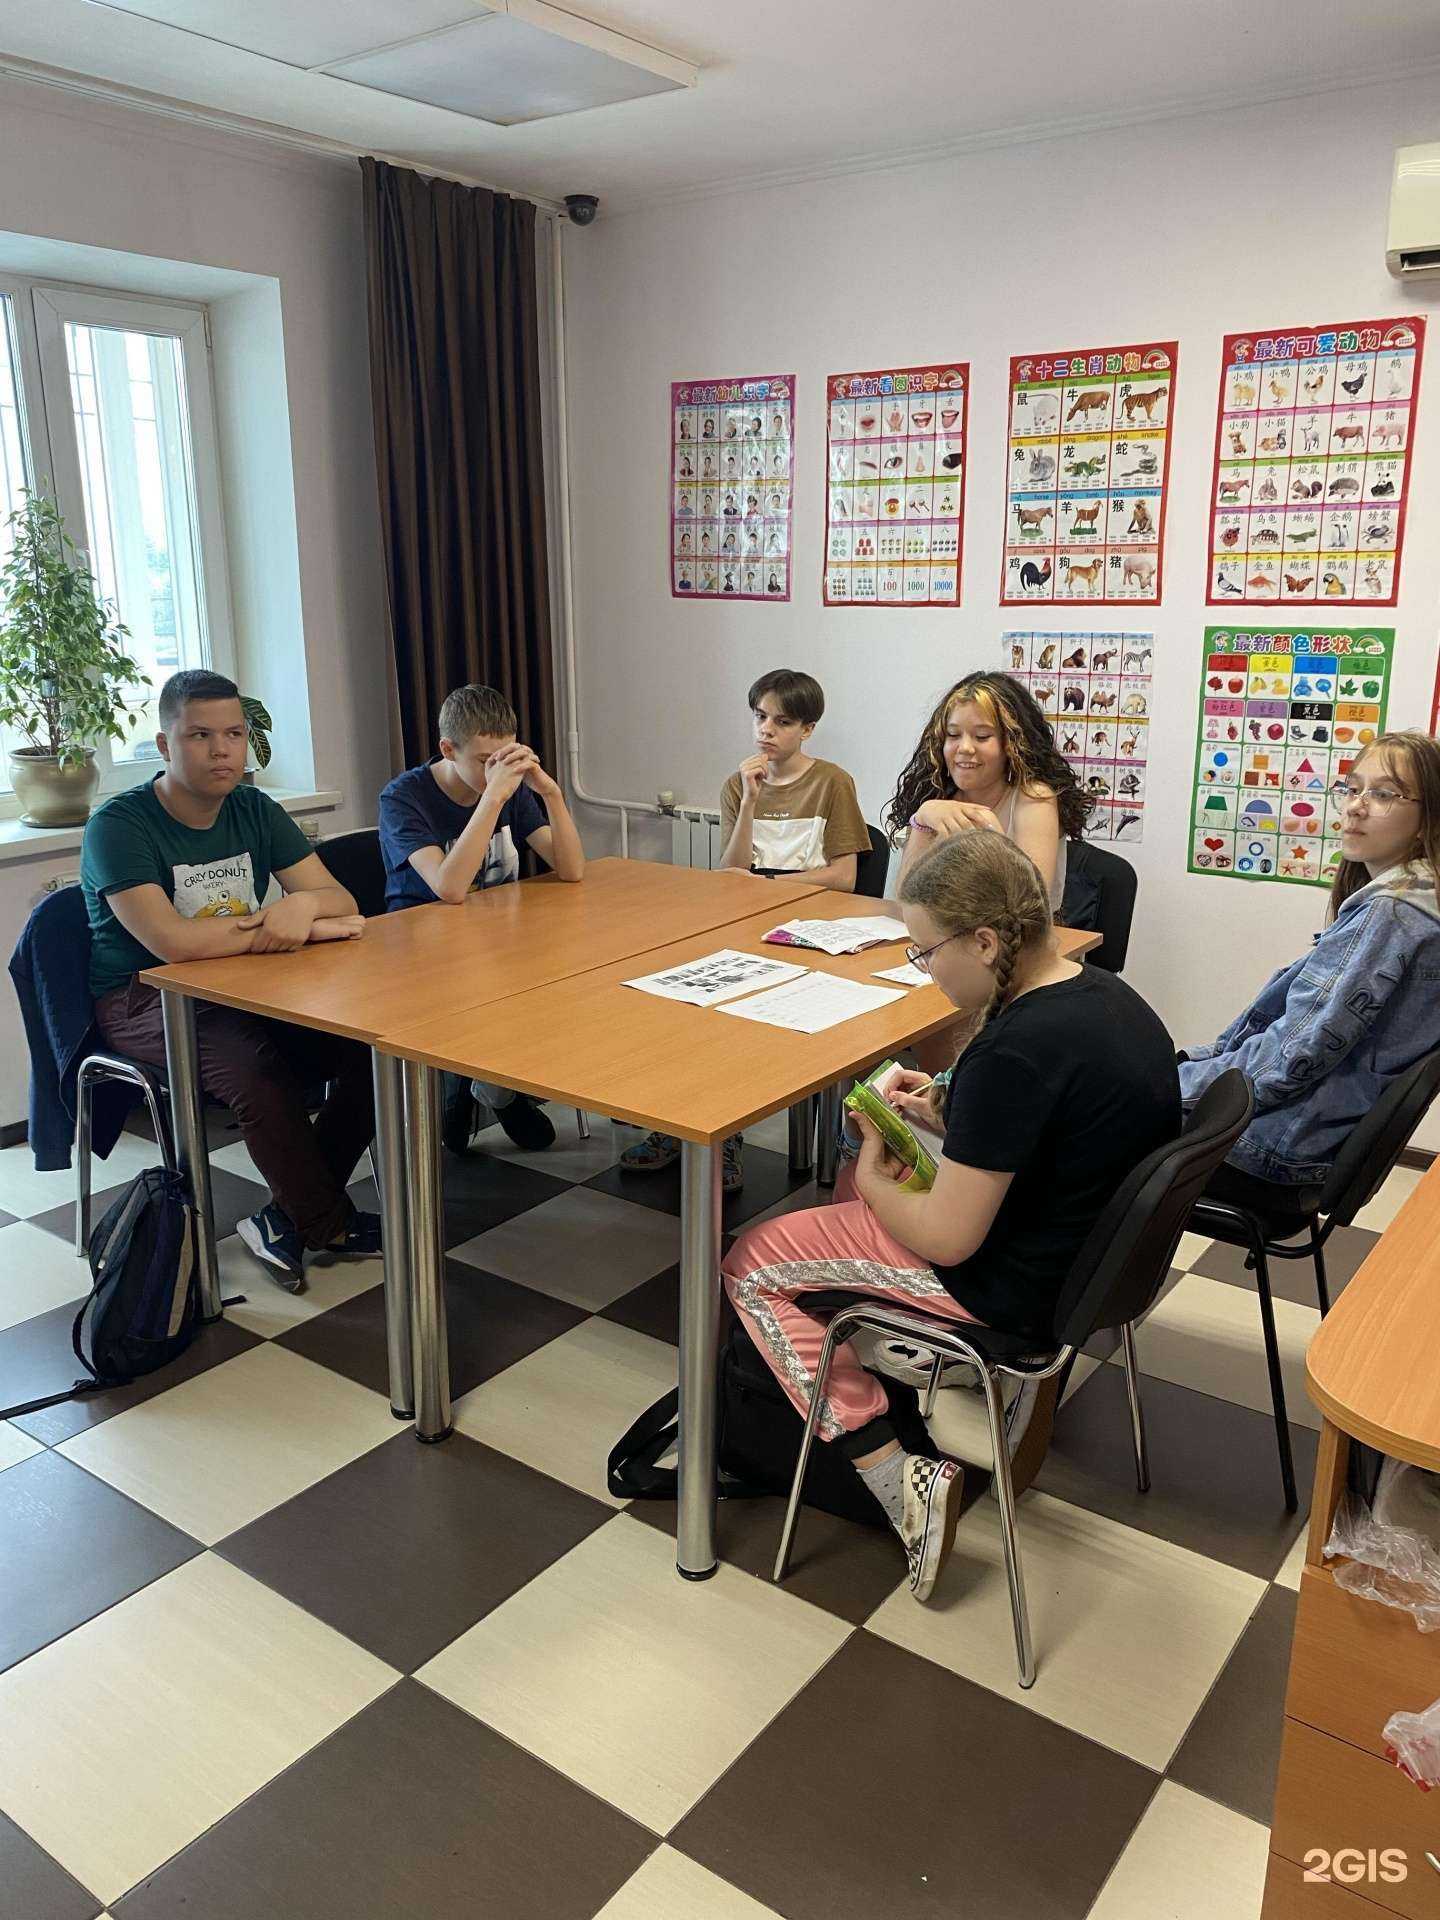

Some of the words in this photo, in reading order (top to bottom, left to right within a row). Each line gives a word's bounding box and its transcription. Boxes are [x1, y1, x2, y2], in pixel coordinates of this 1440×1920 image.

[1254, 330, 1381, 360] 最新可爱动物
[1036, 352, 1141, 380] 十二生肖动物
[1305, 365, 1329, 375] 公鸡
[849, 372, 939, 398] 最新看图识字
[1120, 384, 1132, 397] 虎
[692, 382, 770, 403] 最新幼儿识字
[1017, 392, 1028, 405] 鼠
[1067, 389, 1078, 401] 牛
[1015, 449, 1025, 461] 兔
[1064, 445, 1075, 458] 龙
[1115, 443, 1128, 455] 蛇
[1061, 501, 1072, 514] 羊
[1113, 500, 1124, 512] 猴
[1010, 557, 1020, 569] 鸡
[1060, 556, 1070, 569] 狗
[1110, 556, 1121, 568] 猪
[883, 581, 897, 591] 100
[908, 581, 924, 591] 1000
[934, 581, 953, 591] 10000
[1233, 633, 1353, 655] 最新颜色形状
[208, 868, 247, 880] DONUT
